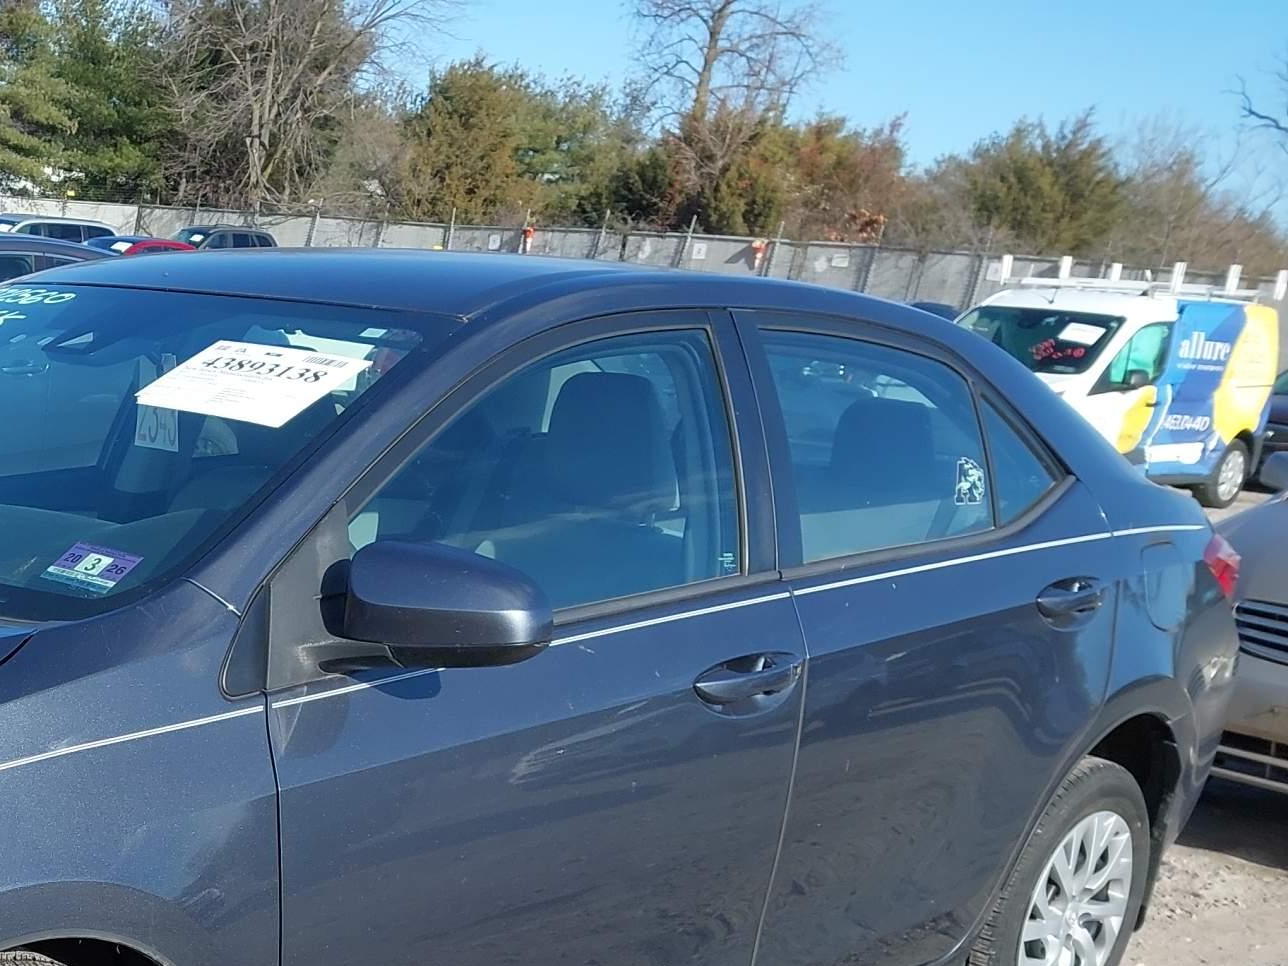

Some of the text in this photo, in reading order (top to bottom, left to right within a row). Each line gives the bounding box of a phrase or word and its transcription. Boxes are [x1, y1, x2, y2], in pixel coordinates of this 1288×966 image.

[1179, 331, 1231, 361] allure
[201, 355, 328, 384] 43893138
[63, 552, 82, 564] 20
[84, 557, 103, 572] 3
[106, 563, 127, 575] 26
